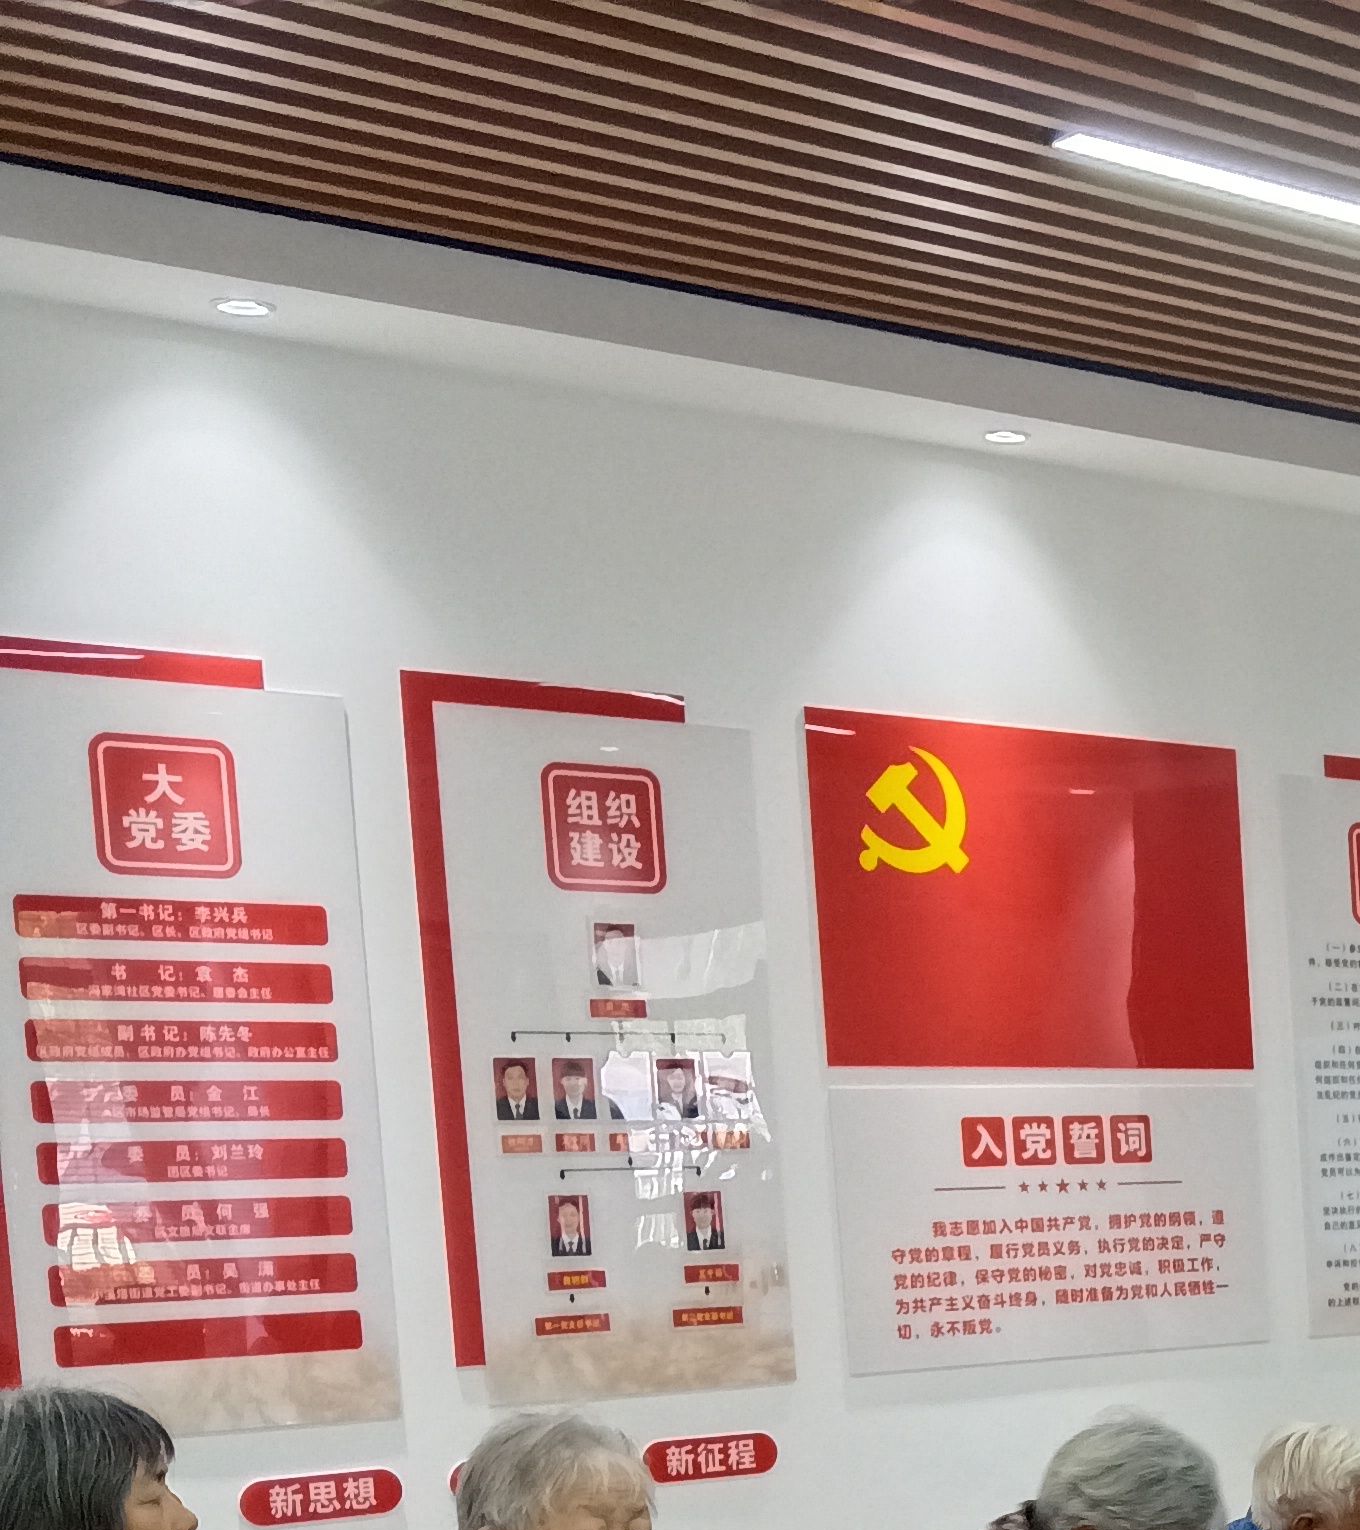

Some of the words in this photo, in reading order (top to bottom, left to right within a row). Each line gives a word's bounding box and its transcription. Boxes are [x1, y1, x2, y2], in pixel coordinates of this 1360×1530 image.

[142, 763, 185, 805] 大
[566, 788, 641, 828] 组织
[122, 808, 212, 852] 党委
[569, 830, 643, 869] 建设
[972, 1122, 1147, 1161] 入党誓词
[932, 1209, 1225, 1239] 我志愿加入中国共产党，拥护党的纲领，遵
[892, 1232, 1226, 1265] 守党的章程，履行党员义务，执行党的决定，严守
[897, 1318, 1003, 1341] 切，永不叛党。
[666, 1439, 757, 1477] 新征程
[269, 1477, 377, 1518] 新思想
